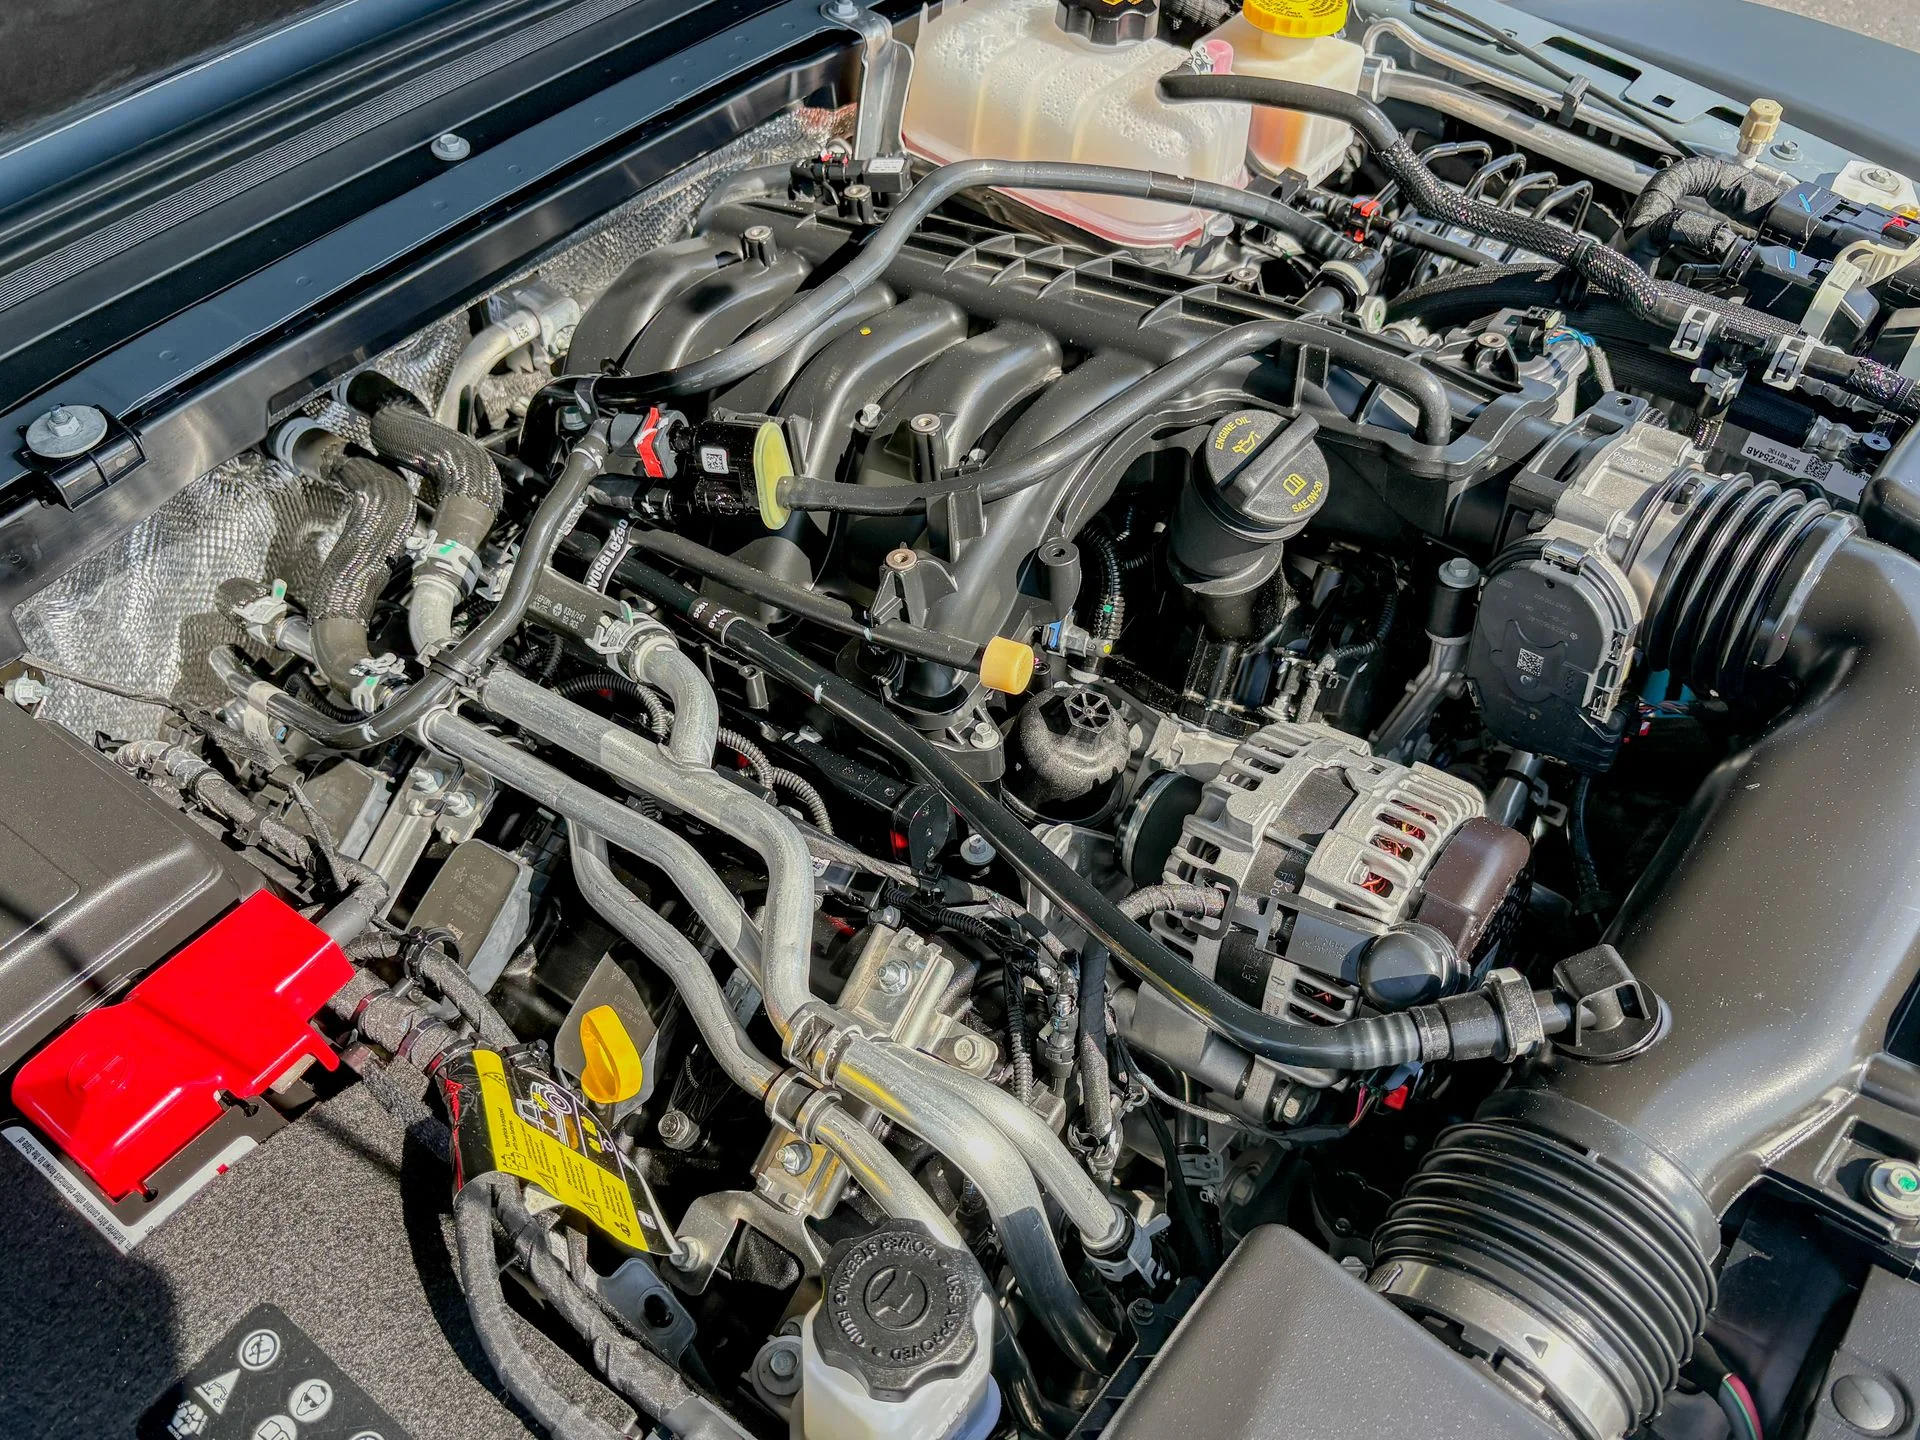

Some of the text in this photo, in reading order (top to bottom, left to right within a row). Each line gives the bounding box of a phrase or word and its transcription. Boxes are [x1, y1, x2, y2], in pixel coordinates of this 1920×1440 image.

[1215, 416, 1251, 450] ENGINE OIL
[1291, 480, 1323, 513] SAE 0W-20
[583, 518, 629, 592] 05281950A
[16, 1135, 27, 1146] of
[20, 1139, 36, 1155] State
[30, 1149, 42, 1161] the
[36, 1155, 46, 1165] to
[40, 1159, 58, 1177] known
[52, 1171, 77, 1196] chemicals
[71, 1190, 87, 1206] other
[81, 1200, 101, 1220] contain
[94, 1213, 110, 1228] also
[104, 1222, 127, 1245] Batteries
[833, 1237, 936, 1348] POWER STEERING FLUID
[945, 1273, 963, 1305] USE
[891, 1309, 960, 1361] APPROVED
